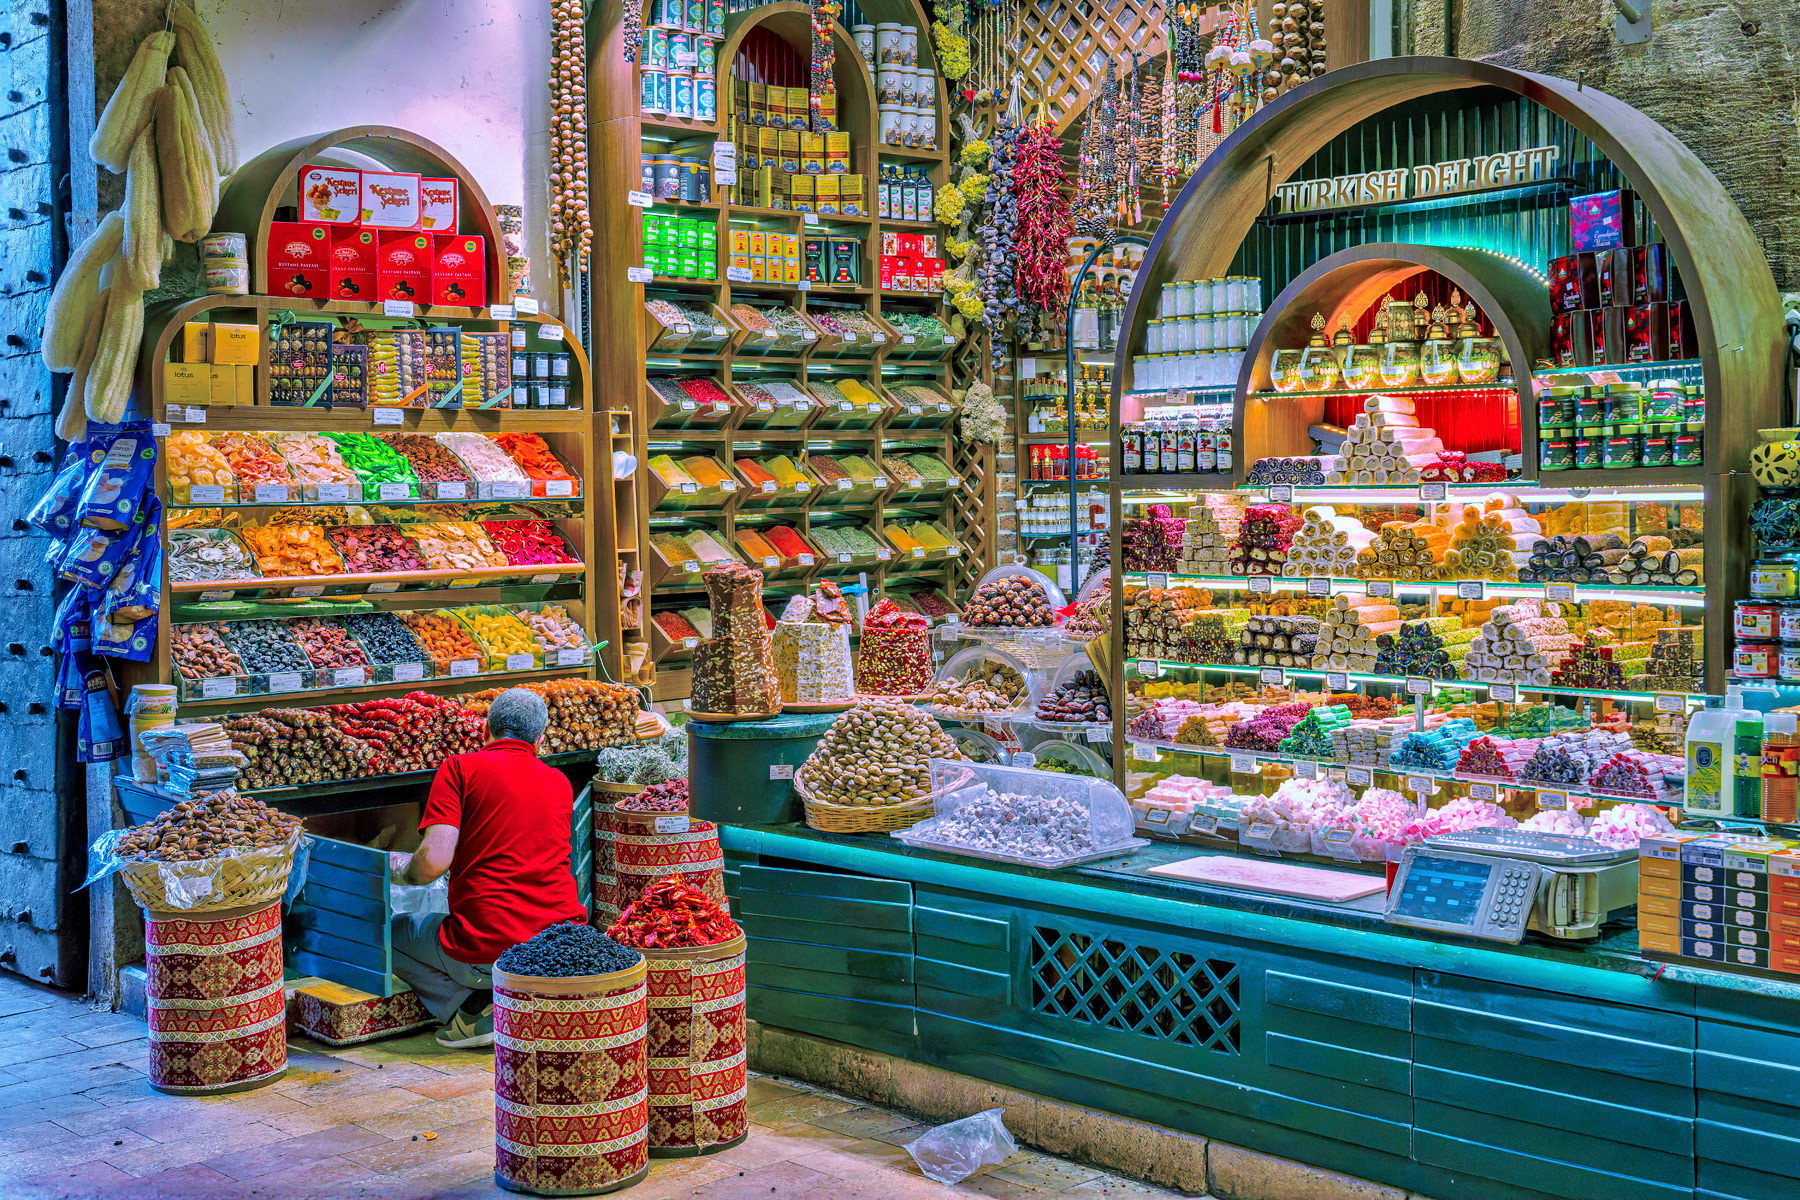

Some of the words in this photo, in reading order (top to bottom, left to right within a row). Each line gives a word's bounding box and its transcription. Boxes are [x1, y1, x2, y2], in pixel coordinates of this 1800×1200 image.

[325, 177, 356, 187] Kestane
[1276, 168, 1409, 214] TURKISH
[1414, 146, 1560, 199] DELIGHT
[369, 184, 408, 196] Kestane
